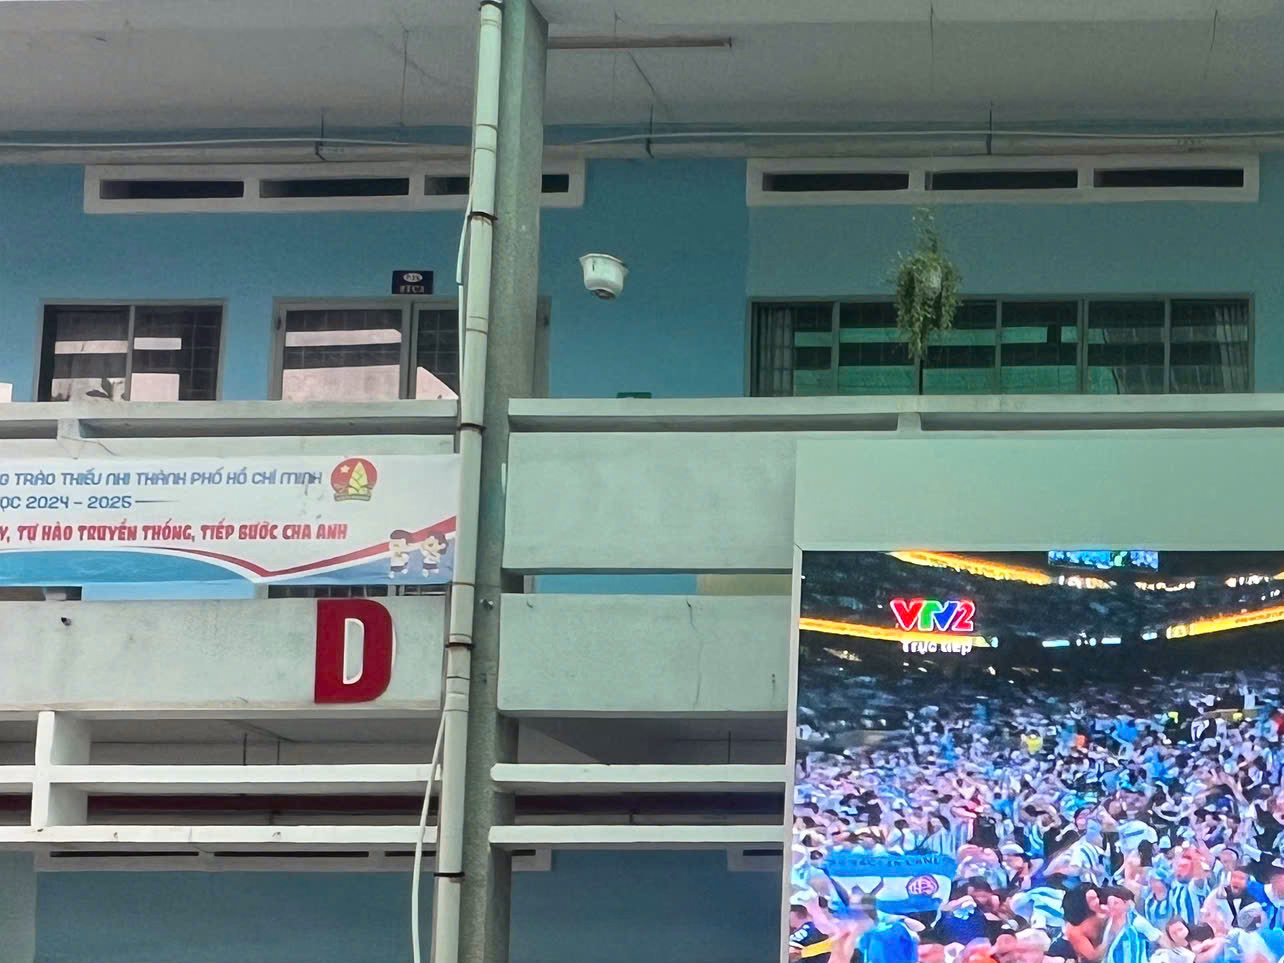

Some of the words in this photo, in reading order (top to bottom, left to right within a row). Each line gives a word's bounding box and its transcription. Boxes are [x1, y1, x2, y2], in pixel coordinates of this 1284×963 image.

[15, 470, 56, 486] TRÀO
[106, 472, 131, 486] NHI
[137, 470, 187, 486] THÀNH
[190, 466, 225, 485] PHỐ
[280, 471, 323, 485] MINH
[26, 496, 69, 509] 2024
[87, 496, 132, 509] 2025
[42, 521, 73, 541] HÀO
[201, 517, 235, 540] TIẾP
[282, 523, 312, 540] CHA
[889, 598, 976, 632] VTV2
[314, 598, 396, 704] D
